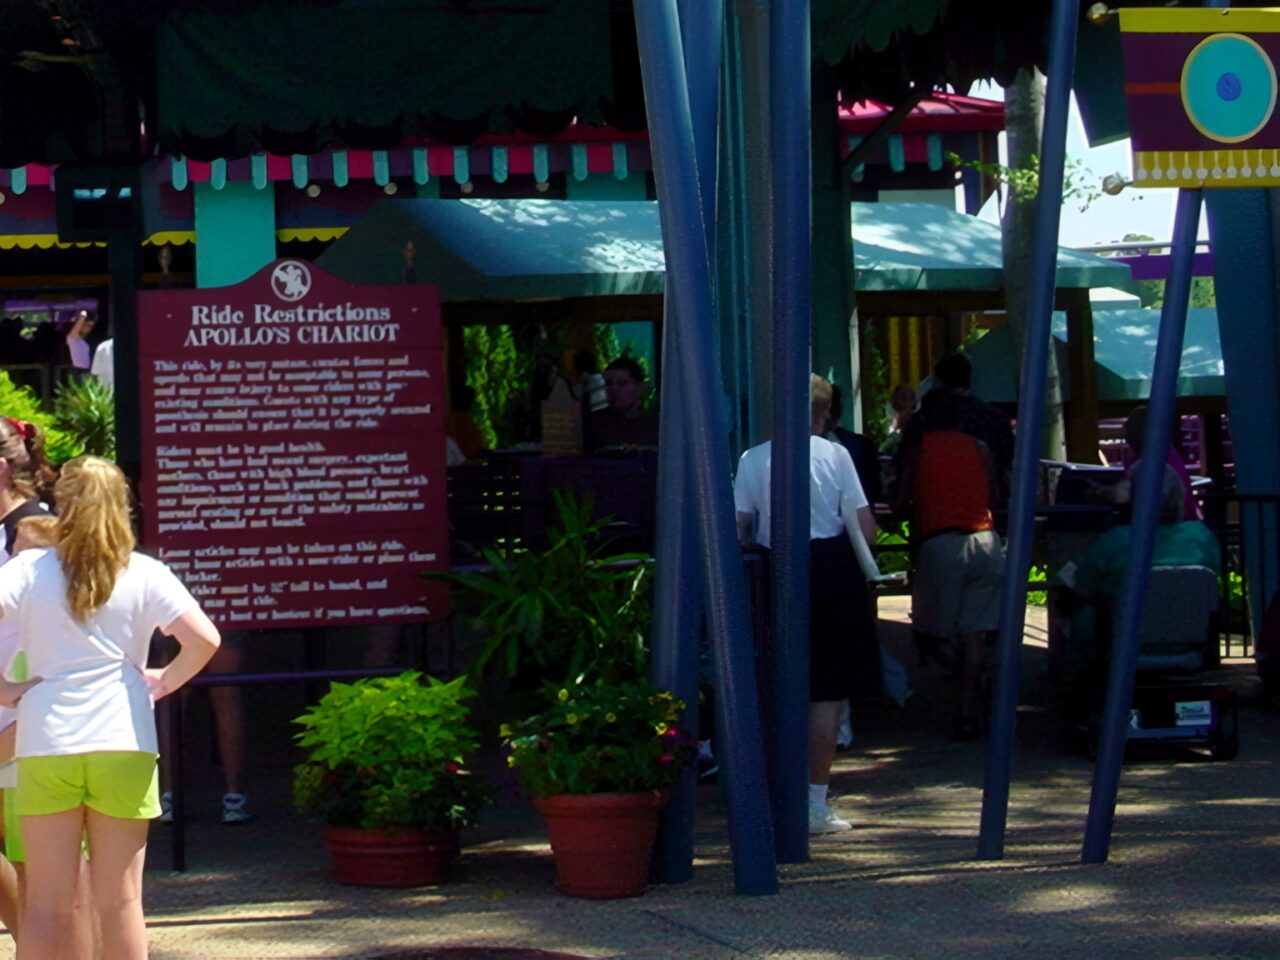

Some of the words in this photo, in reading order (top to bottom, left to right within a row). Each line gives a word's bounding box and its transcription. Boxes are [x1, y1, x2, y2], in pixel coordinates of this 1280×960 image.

[192, 305, 245, 326] Ride
[254, 302, 391, 324] Restrictions
[184, 325, 291, 347] APOLLO'S
[297, 323, 401, 344] CHARIOT
